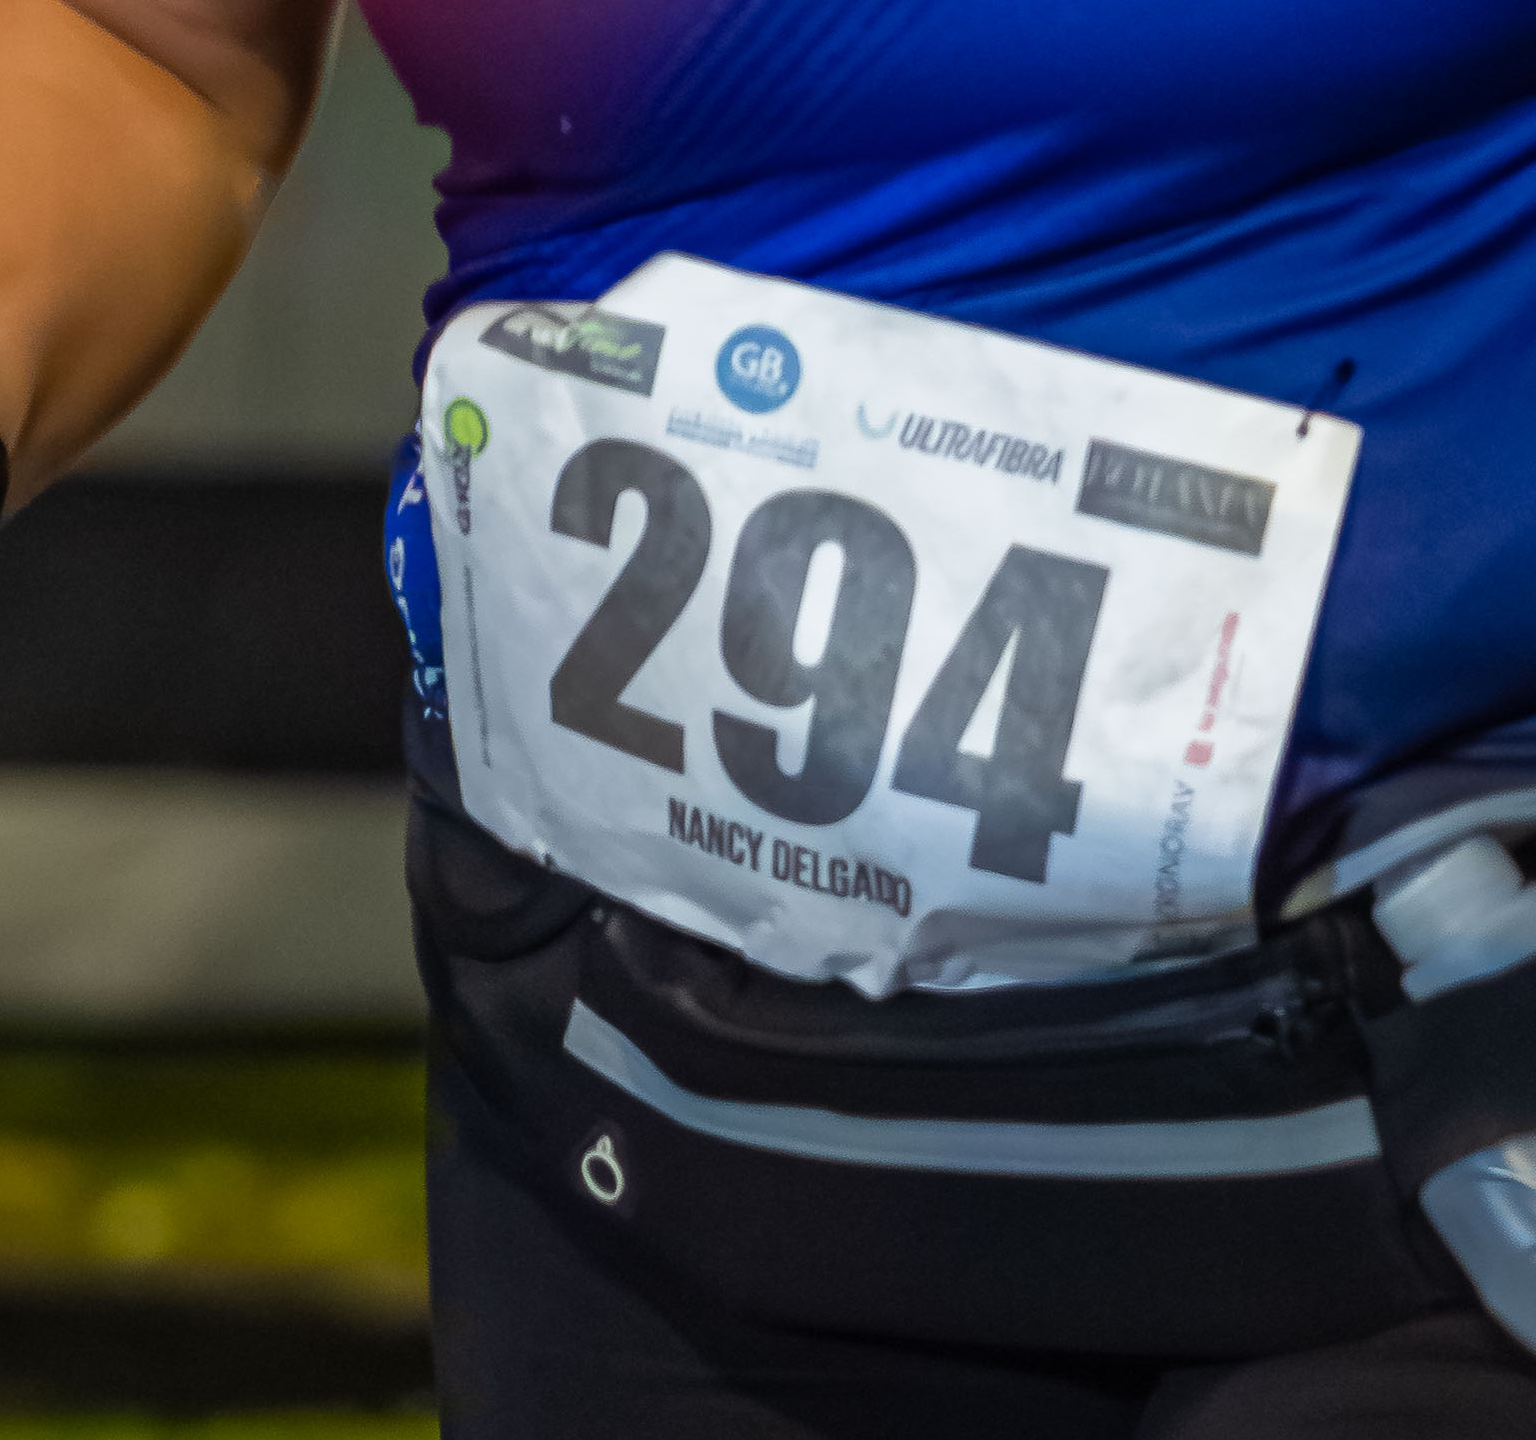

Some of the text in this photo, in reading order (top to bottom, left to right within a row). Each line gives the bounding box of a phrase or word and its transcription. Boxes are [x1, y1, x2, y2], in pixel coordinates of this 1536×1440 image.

[730, 341, 785, 385] GB
[898, 412, 1063, 485] ULTRAFIBRA
[550, 436, 1110, 884] 294
[667, 797, 912, 917] NANCY DELGADO
